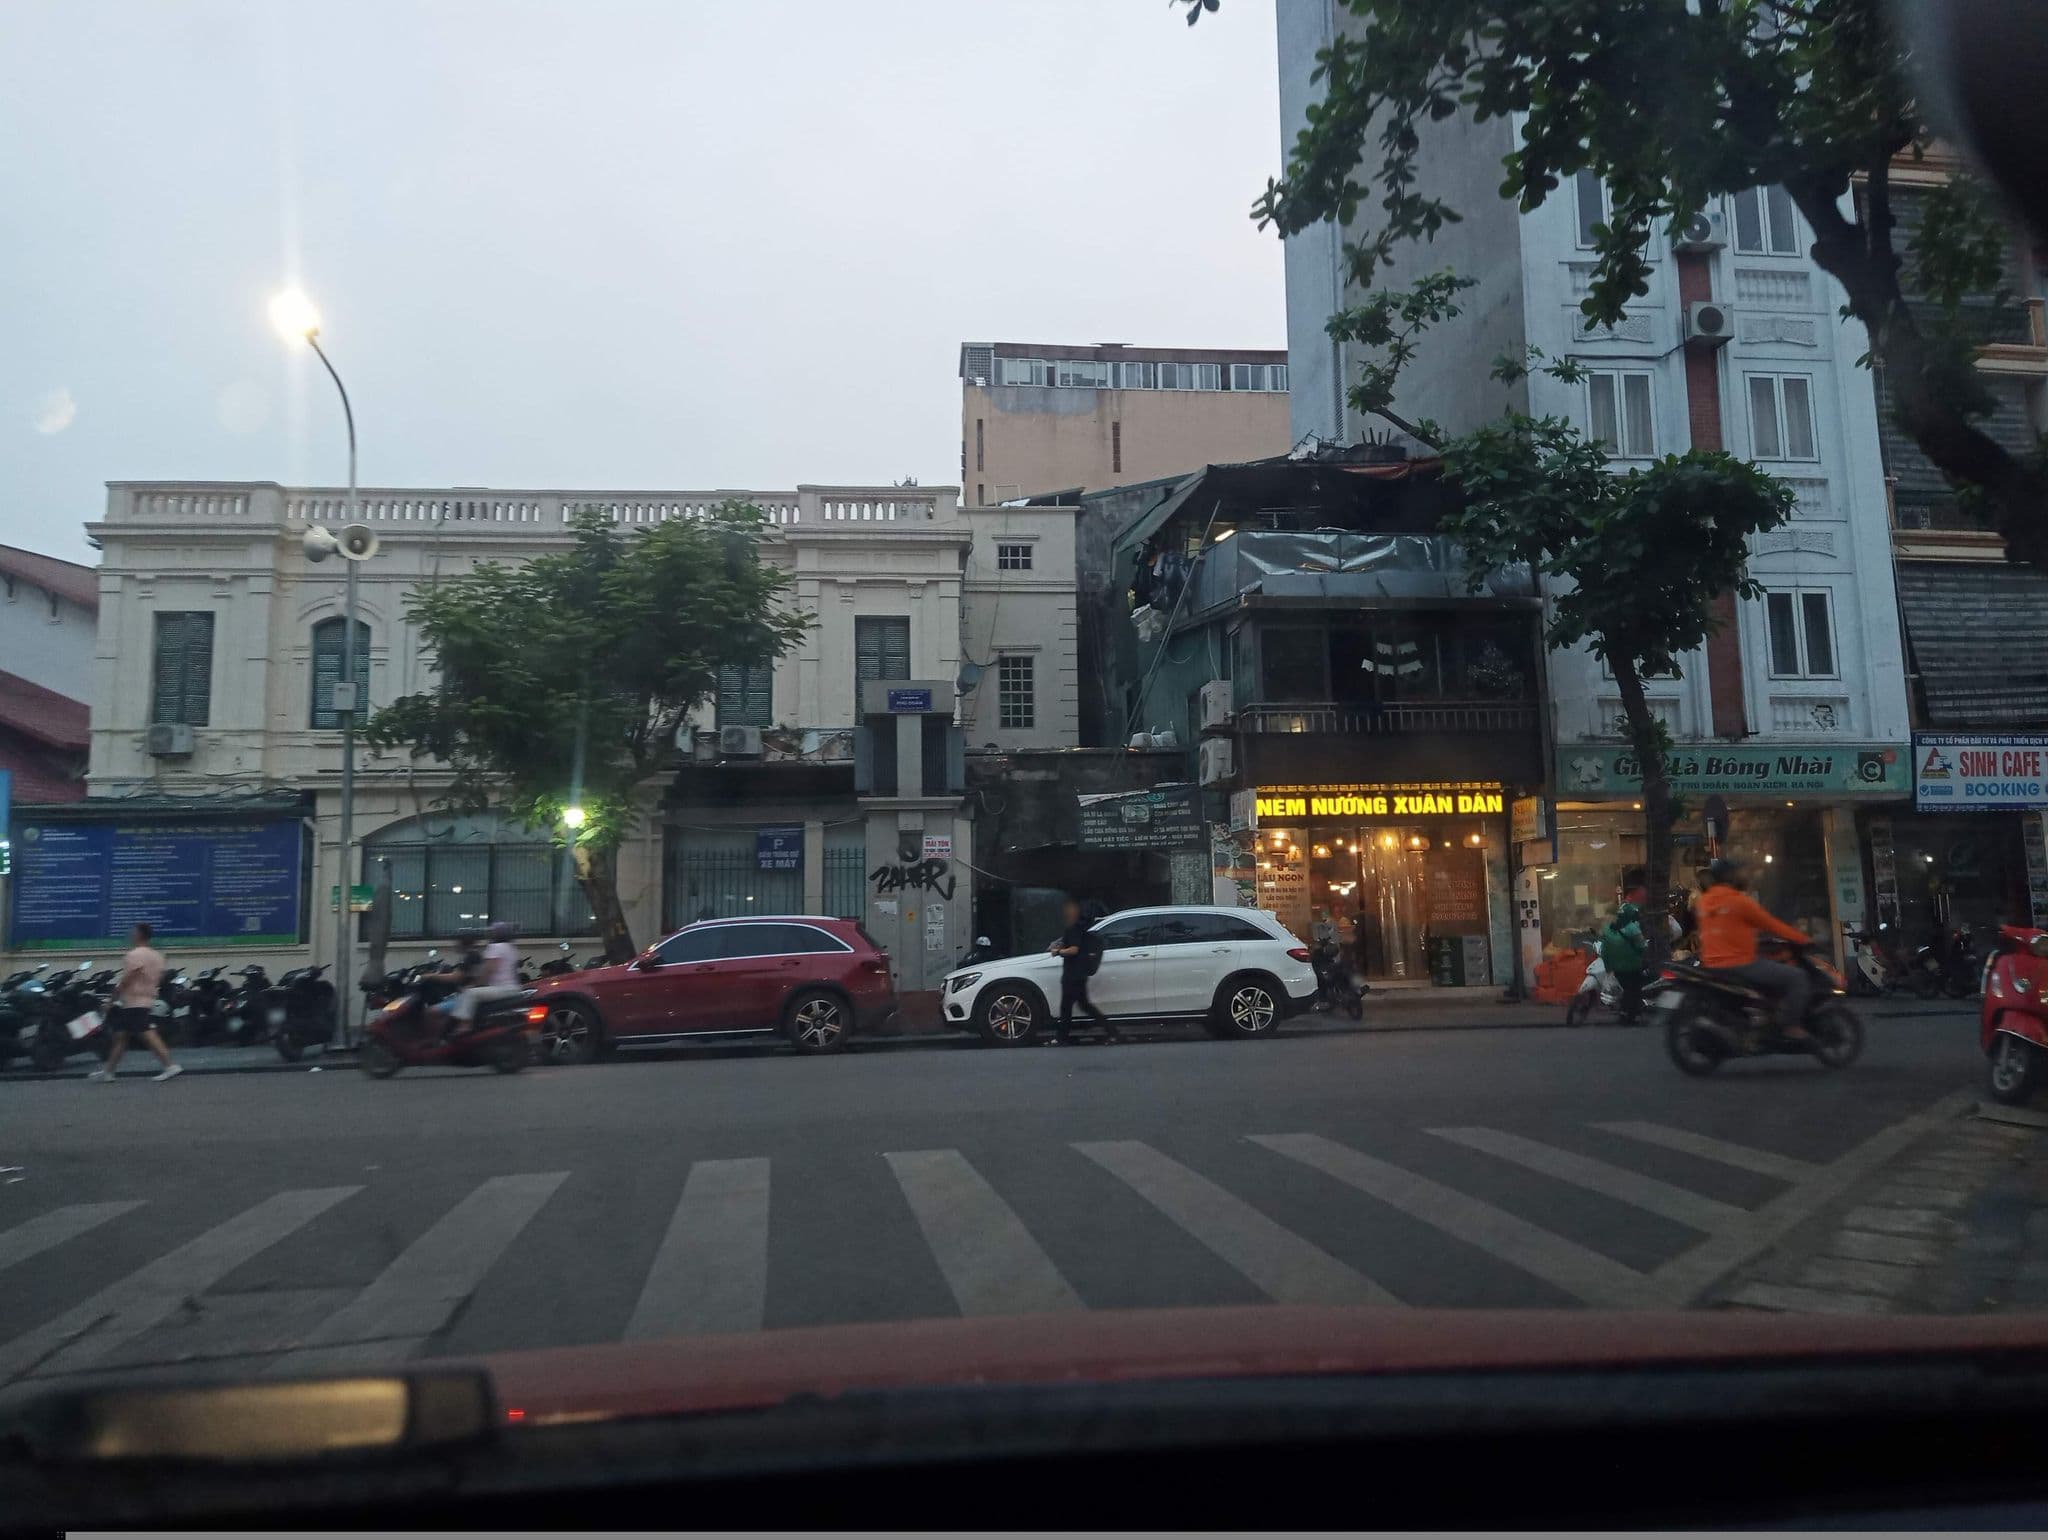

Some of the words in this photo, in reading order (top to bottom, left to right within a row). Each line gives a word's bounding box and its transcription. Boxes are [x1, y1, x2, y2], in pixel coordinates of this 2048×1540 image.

[1705, 757, 1770, 779] Bông
[1776, 756, 1833, 775] Nhài
[1959, 751, 1997, 777] SINH
[2002, 751, 2041, 777] CAFE
[1965, 782, 2040, 797] BOOKING
[1256, 798, 1306, 817] NEM
[1311, 793, 1388, 815] NƯỚNG
[1393, 793, 1453, 815] XUÂN
[773, 838, 784, 850] P
[1277, 873, 1305, 882] NGON
